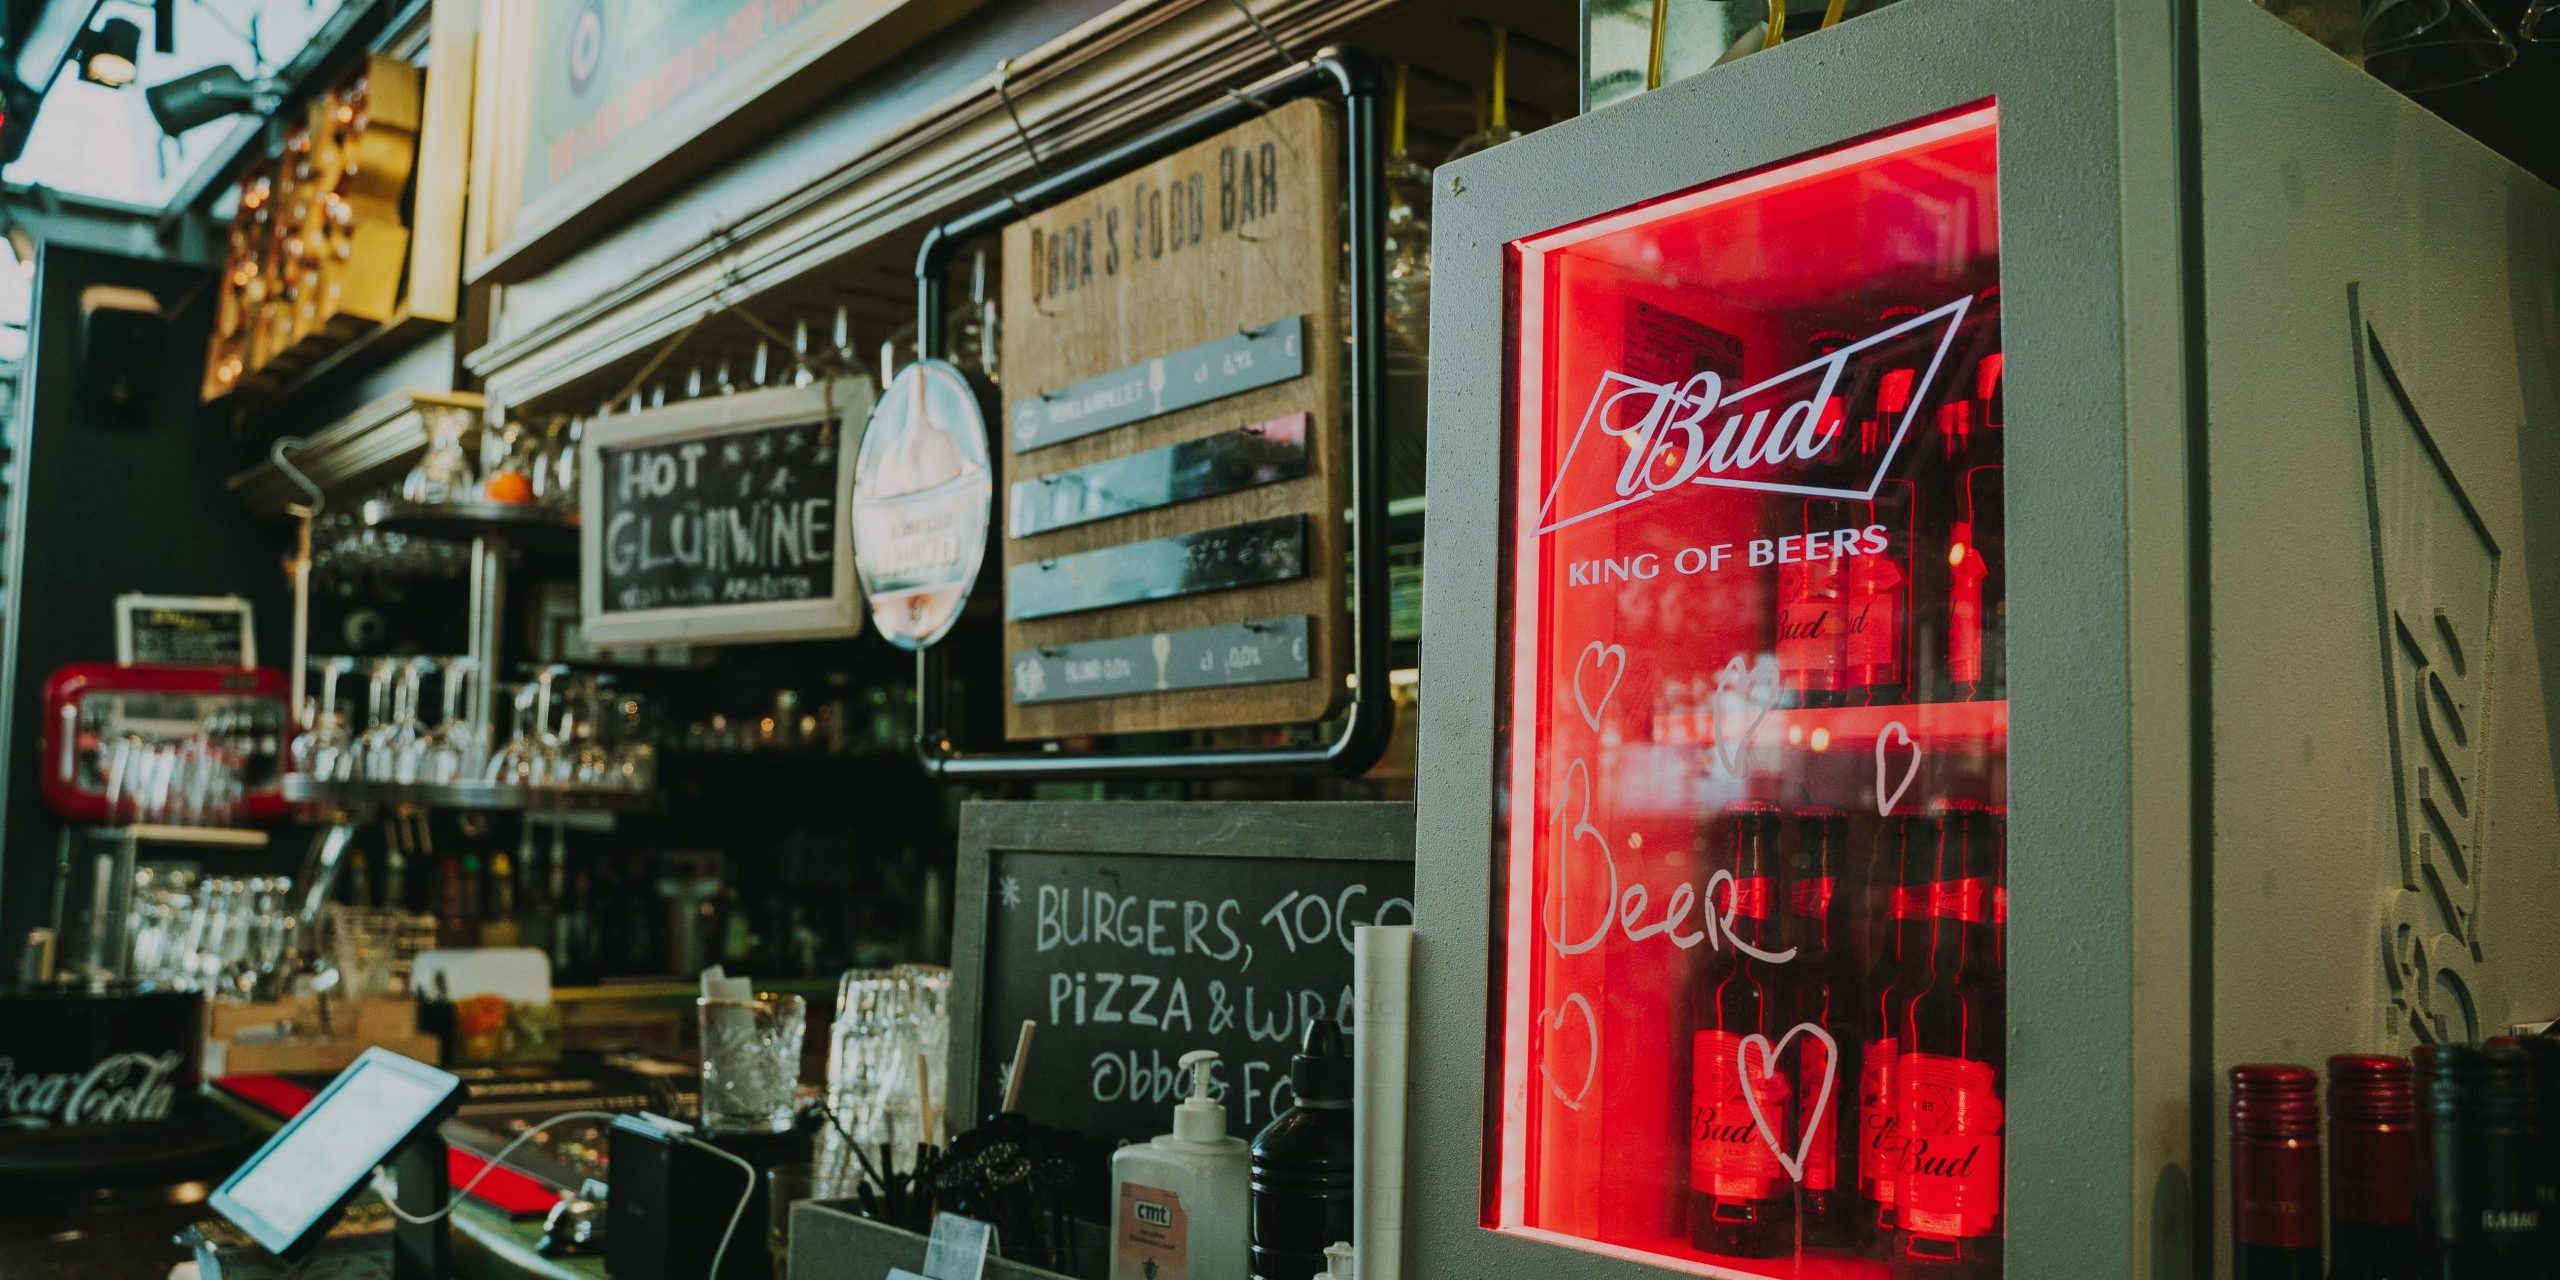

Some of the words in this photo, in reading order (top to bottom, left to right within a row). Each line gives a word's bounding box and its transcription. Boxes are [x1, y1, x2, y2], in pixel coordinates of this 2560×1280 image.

[1133, 171, 1204, 264] FOOD
[1219, 141, 1277, 232] BAR
[1600, 346, 1848, 497] Bud
[617, 444, 706, 499] HOT
[1569, 553, 1661, 587] KING
[1674, 543, 1733, 576] OF
[1748, 523, 1889, 567] BEERS
[1036, 884, 1253, 973] BURGERS,
[1207, 979, 1235, 1035] &
[1895, 1135, 1980, 1179] Bud
[1137, 1203, 1168, 1224] cmt
